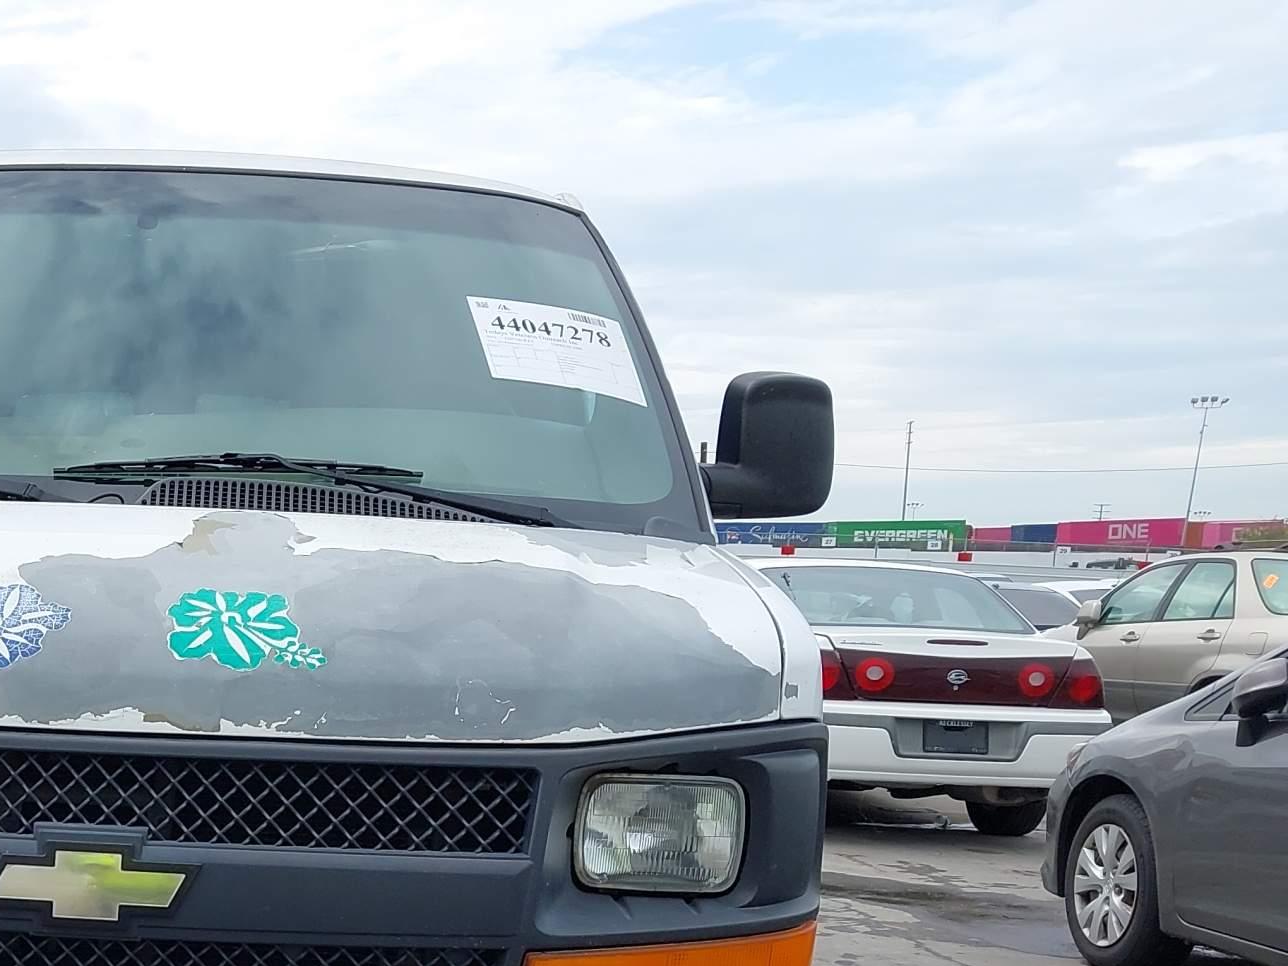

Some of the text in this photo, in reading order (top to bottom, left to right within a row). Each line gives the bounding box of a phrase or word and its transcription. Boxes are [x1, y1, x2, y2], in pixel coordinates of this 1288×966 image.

[491, 315, 611, 347] 44047278
[854, 529, 948, 542] EVERGREEN
[1108, 524, 1149, 540] ONE
